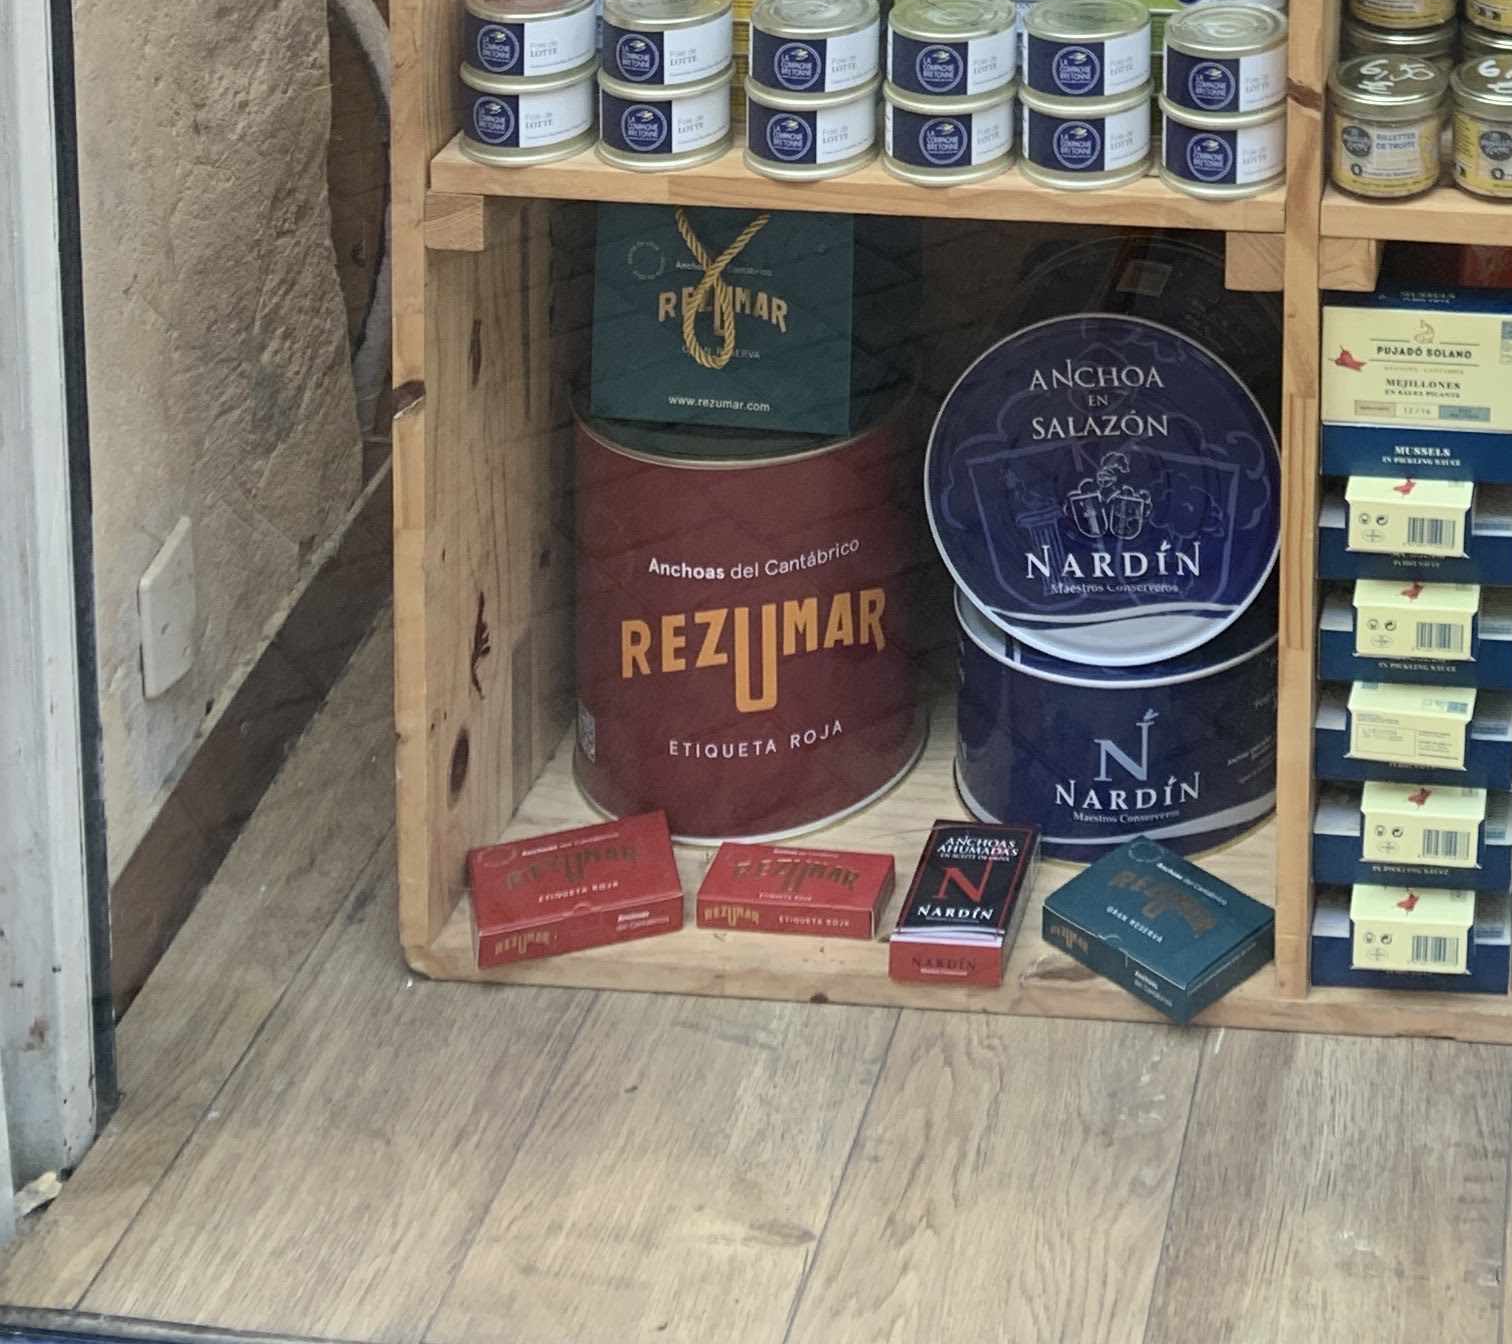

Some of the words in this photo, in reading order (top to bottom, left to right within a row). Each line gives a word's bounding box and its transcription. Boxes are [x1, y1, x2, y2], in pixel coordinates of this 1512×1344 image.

[530, 46, 559, 58] LOTTE
[669, 54, 698, 66] LOTTE
[831, 62, 857, 73] LOTTE
[525, 119, 554, 130] LOTTE
[677, 122, 705, 134] LOTTE
[821, 134, 849, 145] LOTTE
[1376, 345, 1423, 356] PUJADÓ
[1426, 346, 1472, 360] SOLANO
[1029, 359, 1166, 394] ANCHOA
[1386, 378, 1461, 390] MEJILLONES
[668, 395, 770, 412] www.rezumar.com
[1089, 394, 1109, 407] EN
[1032, 410, 1169, 442] SALAZÓN
[1394, 446, 1451, 457] MUSSELS
[648, 556, 726, 581] Anchoas
[730, 558, 760, 581] del
[764, 537, 860, 578] Cantábrico
[1025, 540, 1201, 581] NARDÍN
[1050, 582, 1104, 595] Maestros
[620, 587, 889, 714] REZUMAR
[669, 737, 778, 760] ETIQUETA
[789, 719, 845, 750] ROJA
[1055, 772, 1201, 812] NARDÍN
[944, 832, 1017, 850] ANCHOAS
[538, 887, 588, 903] ETIQUETA
[704, 906, 760, 926] REZUMAR
[918, 904, 994, 920] NARDÍN
[779, 915, 823, 926] ETIQUETA
